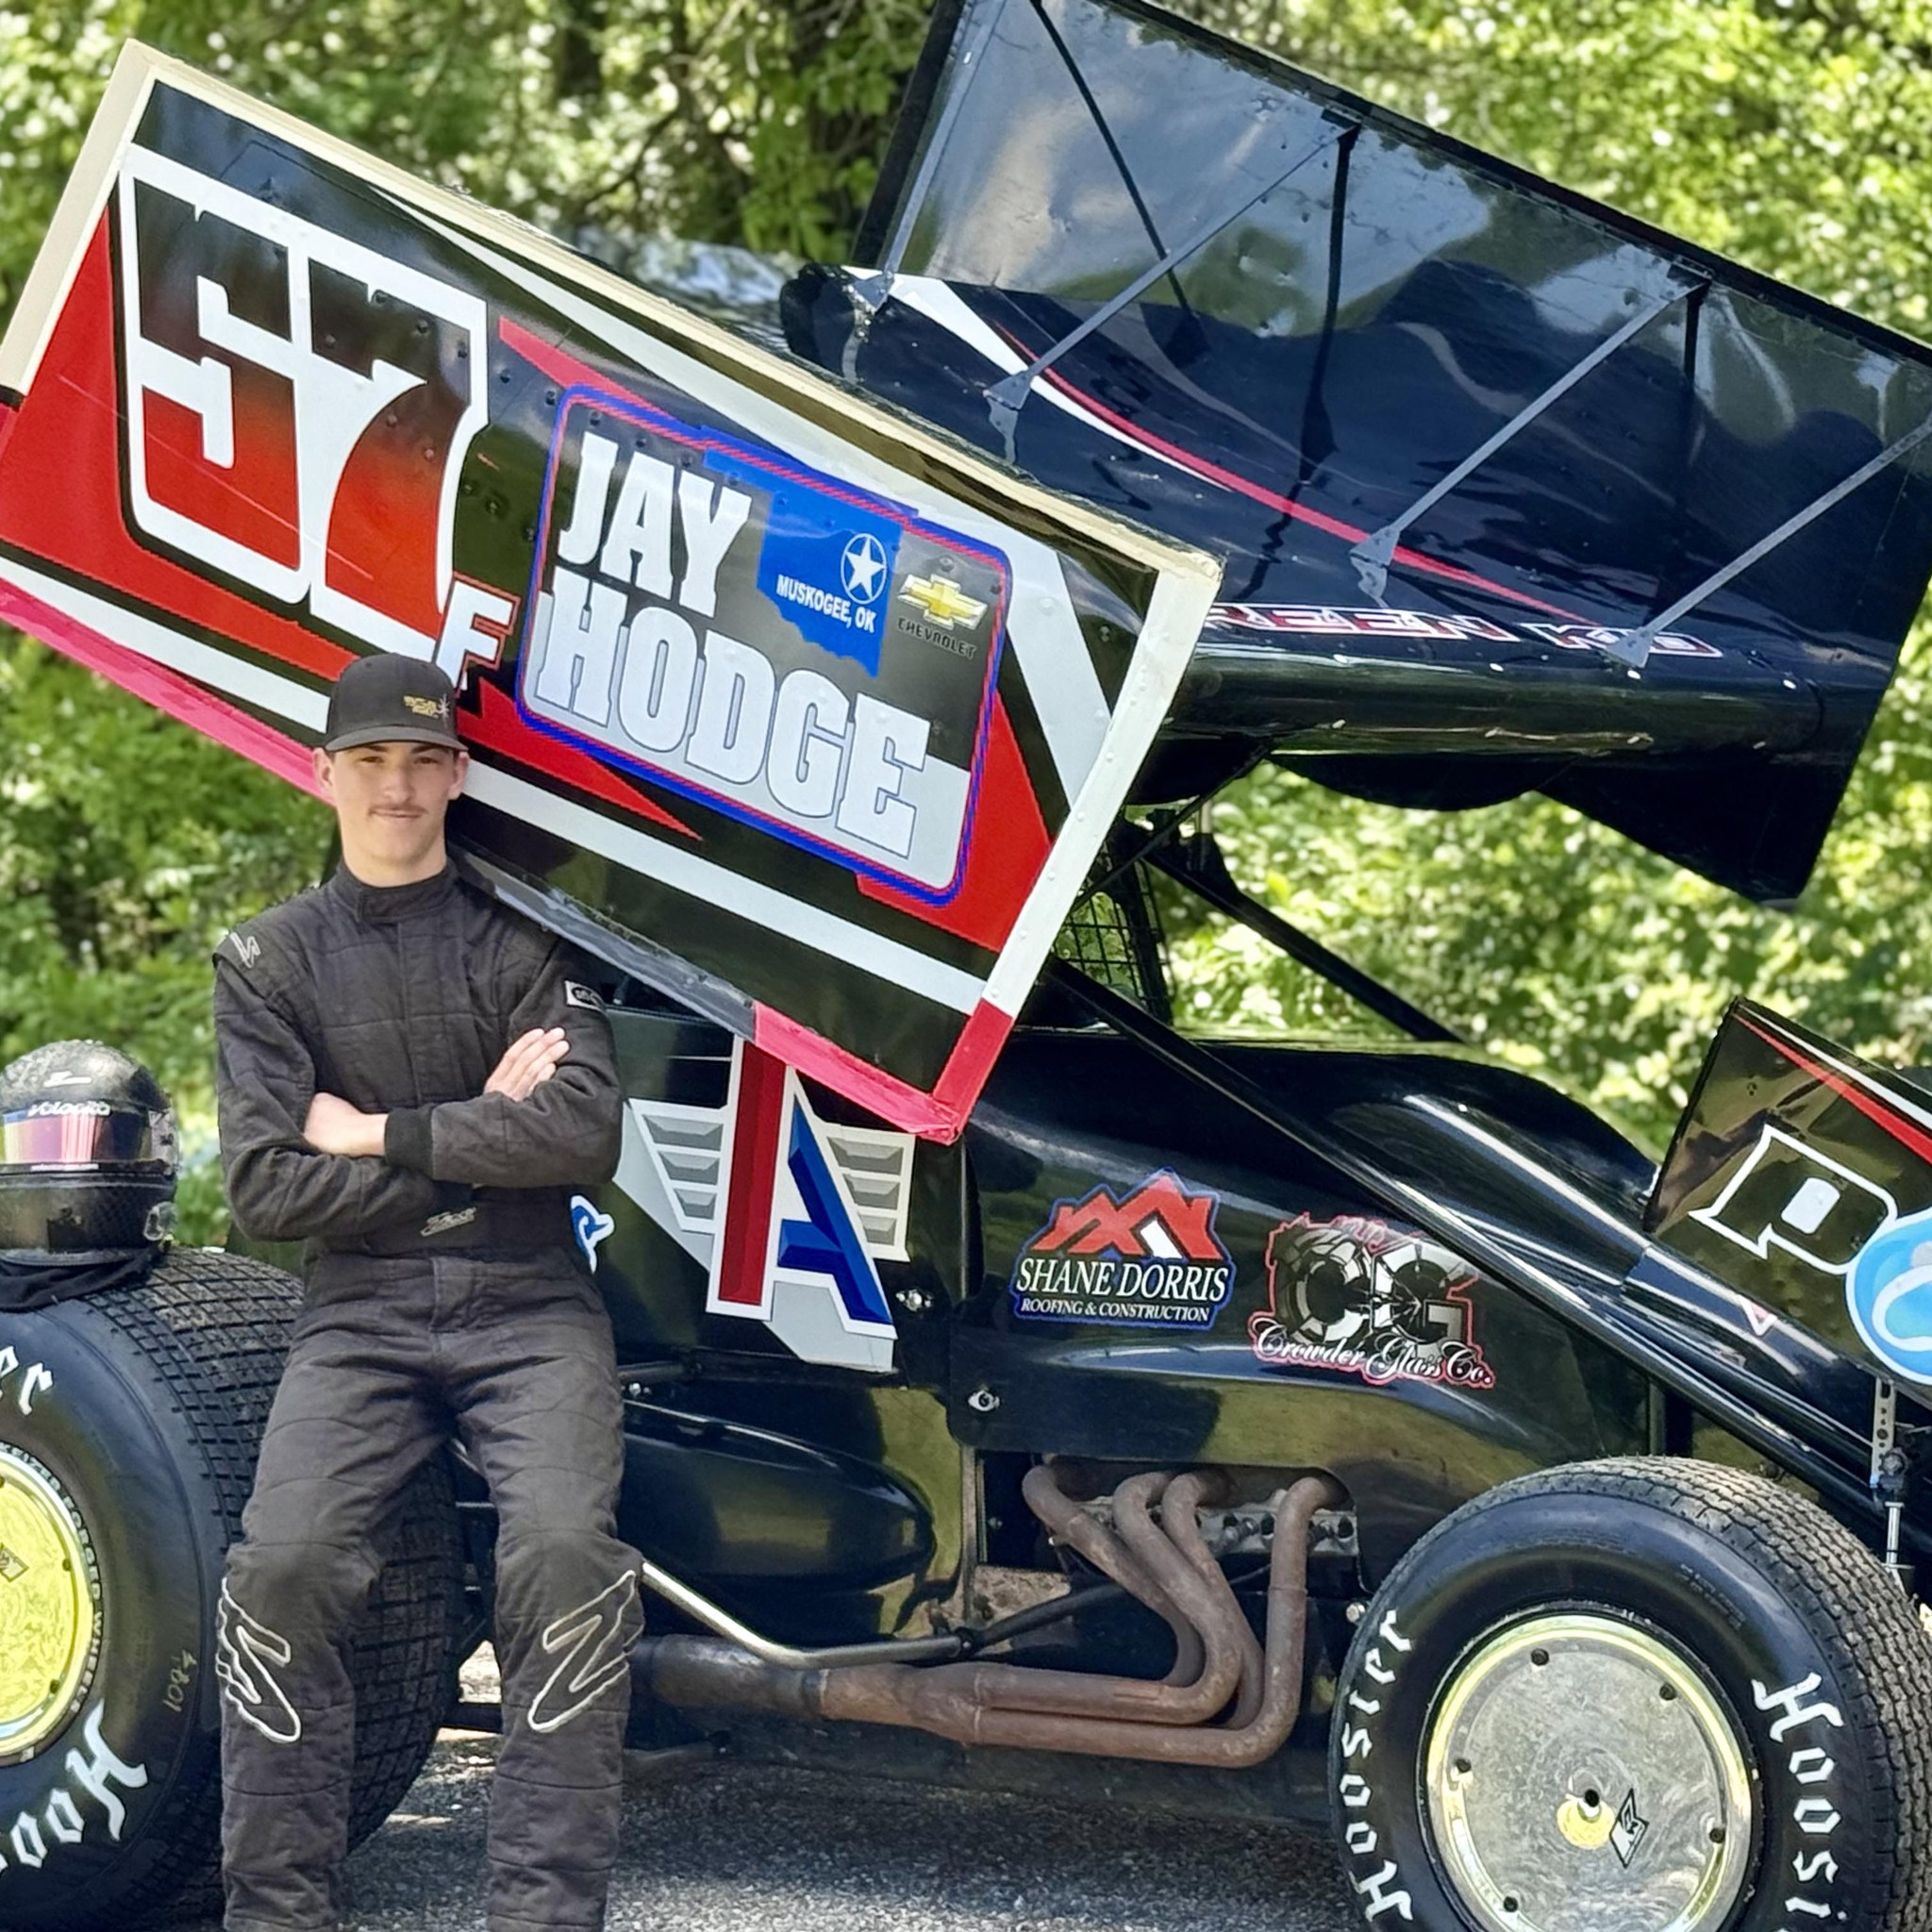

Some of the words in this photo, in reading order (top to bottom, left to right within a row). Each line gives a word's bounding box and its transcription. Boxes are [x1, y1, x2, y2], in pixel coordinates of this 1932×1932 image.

[121, 143, 488, 666] 57
[558, 431, 752, 618] JAY
[776, 575, 853, 627] MUSKOGEE,
[855, 607, 877, 633] OK
[536, 566, 931, 858] HODGE
[897, 617, 977, 659] CHEVROLET
[1016, 1257, 1116, 1296] SHANE
[1117, 1263, 1228, 1302] DORRIS
[1020, 1297, 1084, 1316] ROOFING
[1085, 1300, 1097, 1316] &
[1099, 1302, 1210, 1322] CONSTRUCTION
[1252, 1317, 1365, 1367] Crowder
[1366, 1331, 1444, 1379] Glass
[1441, 1341, 1492, 1384] Co.
[0, 1698, 148, 1869] Hoo
[1339, 1609, 1413, 1922] Hoosier
[1751, 1672, 1848, 1932] Hoosi
